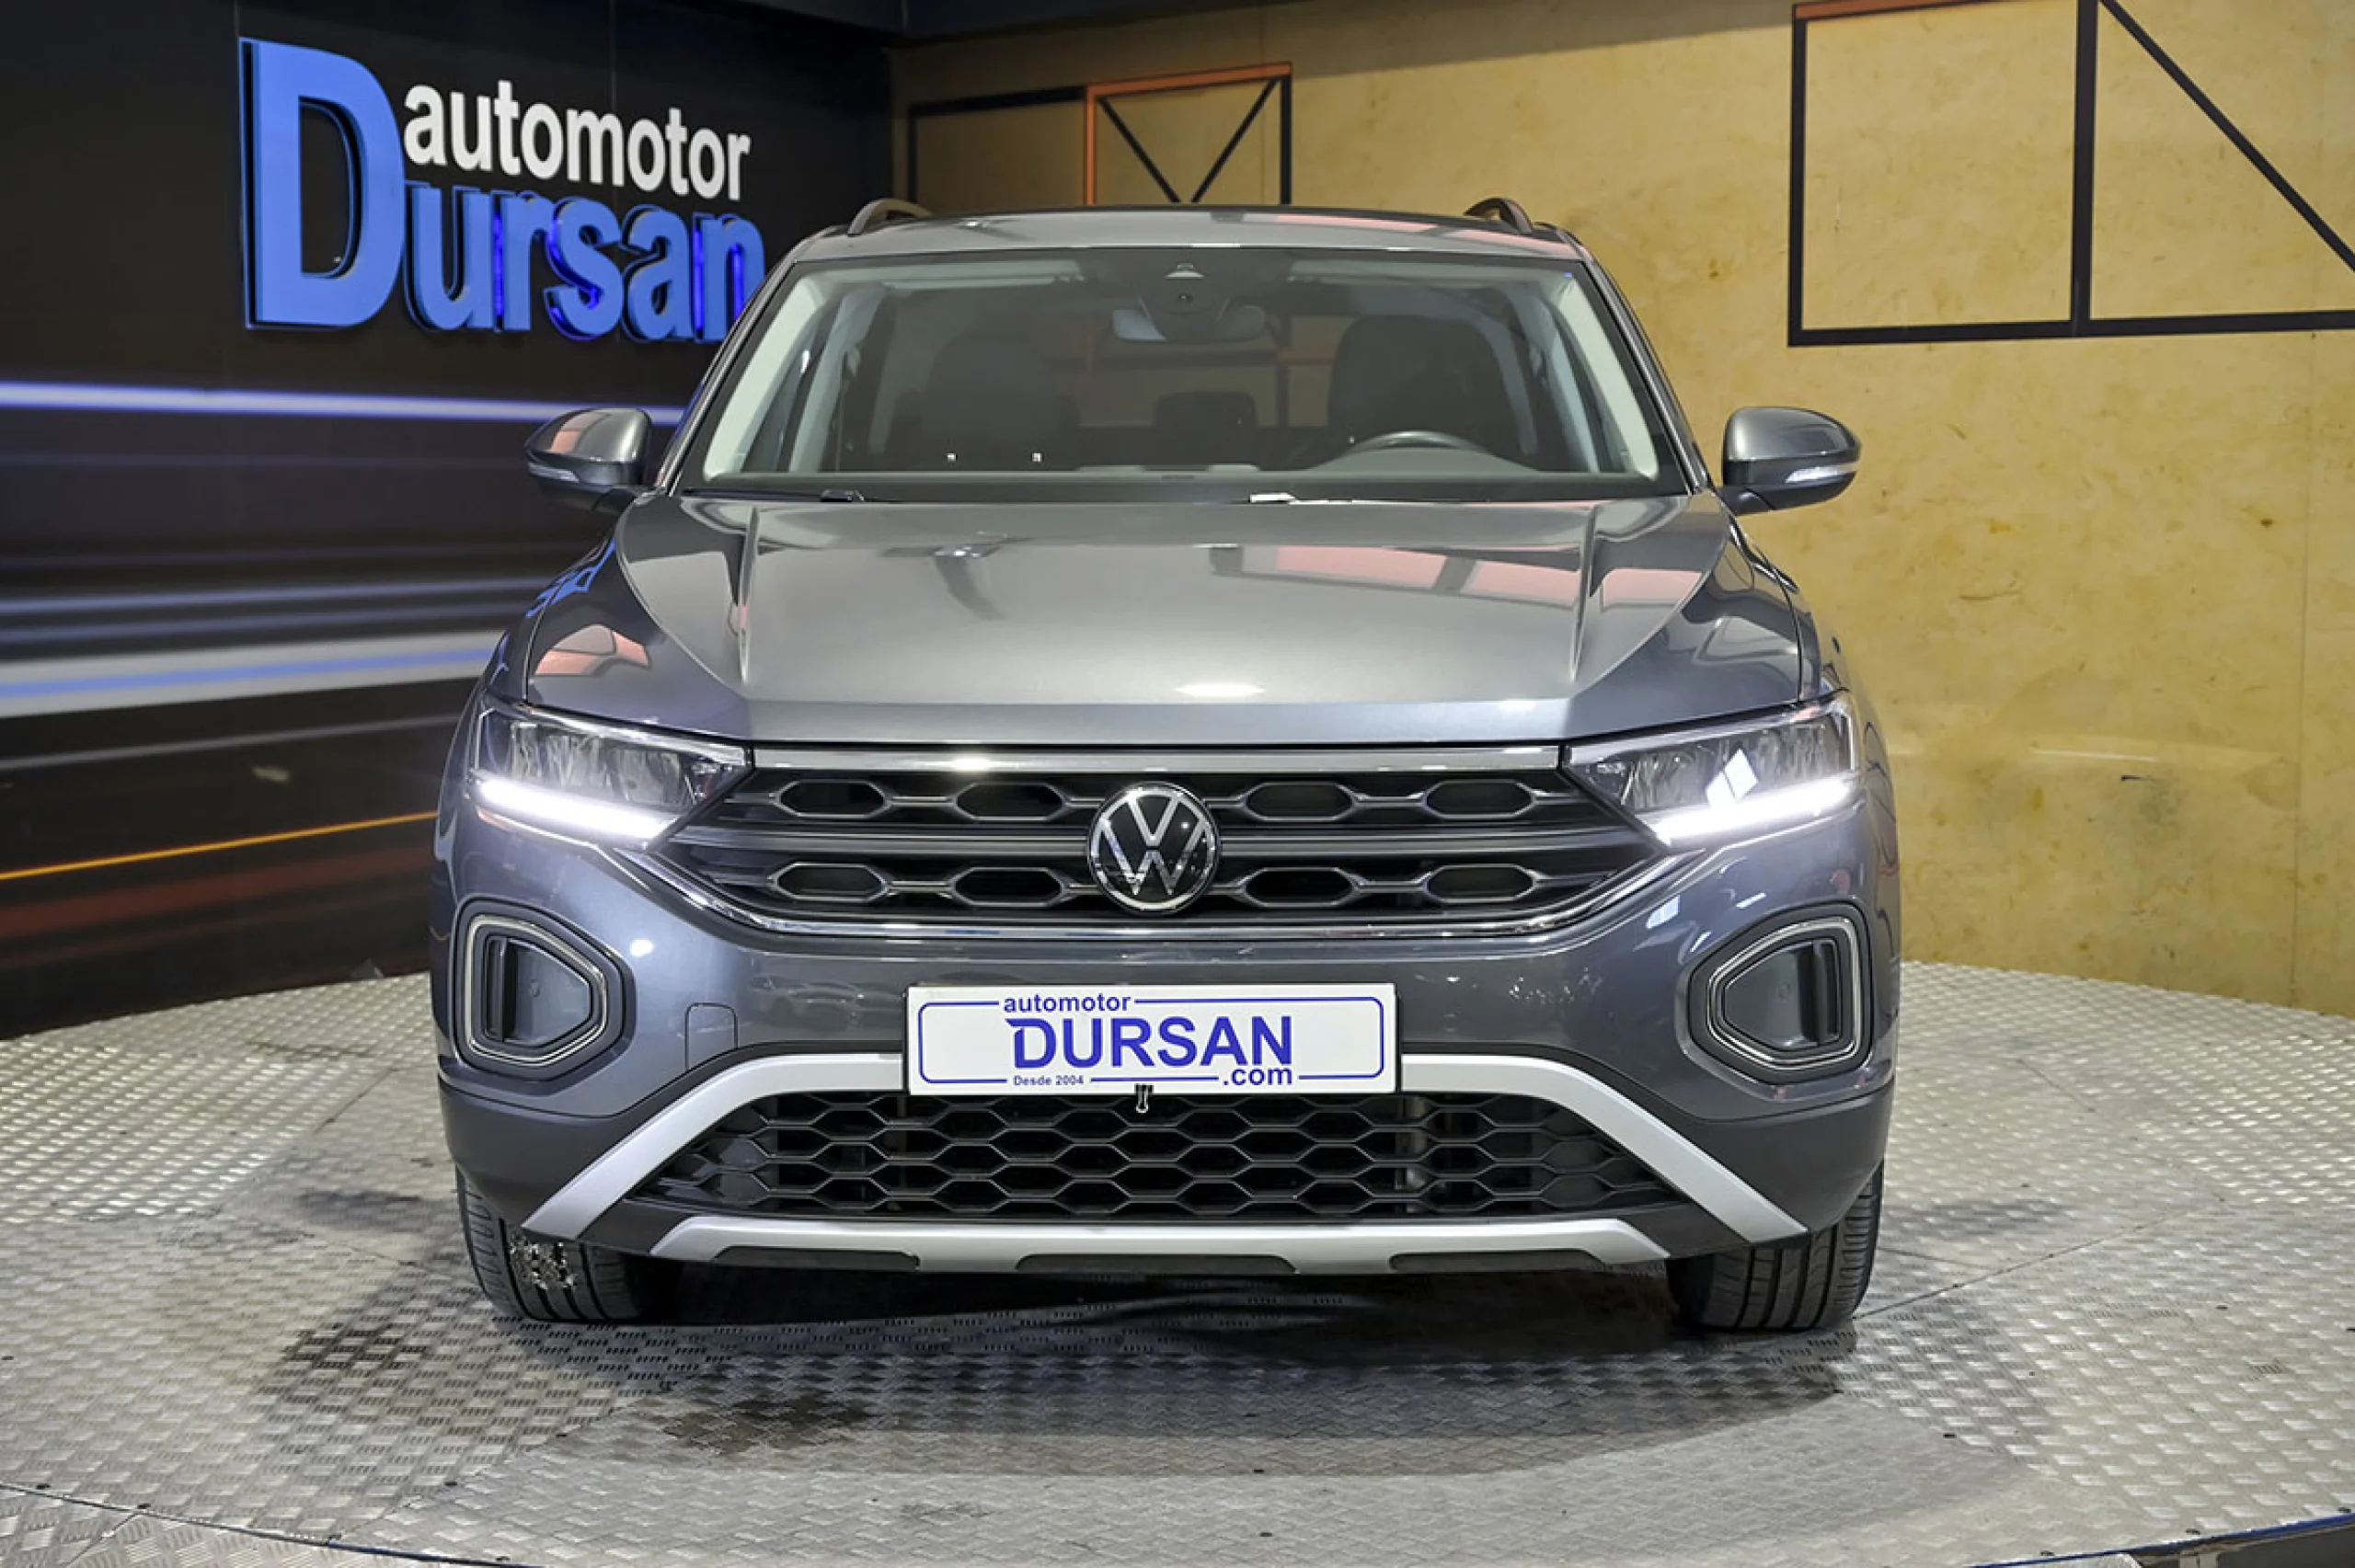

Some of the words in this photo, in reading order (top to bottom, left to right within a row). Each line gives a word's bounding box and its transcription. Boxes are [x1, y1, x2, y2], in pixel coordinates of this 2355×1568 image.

[403, 79, 752, 200] automotor
[238, 36, 765, 343] Dursan
[1004, 992, 1132, 1013] automotor
[1005, 1015, 1292, 1069] DURSAN
[1013, 1074, 1052, 1086] Desde
[1055, 1074, 1085, 1086] 2004
[1223, 1065, 1292, 1086] .com
